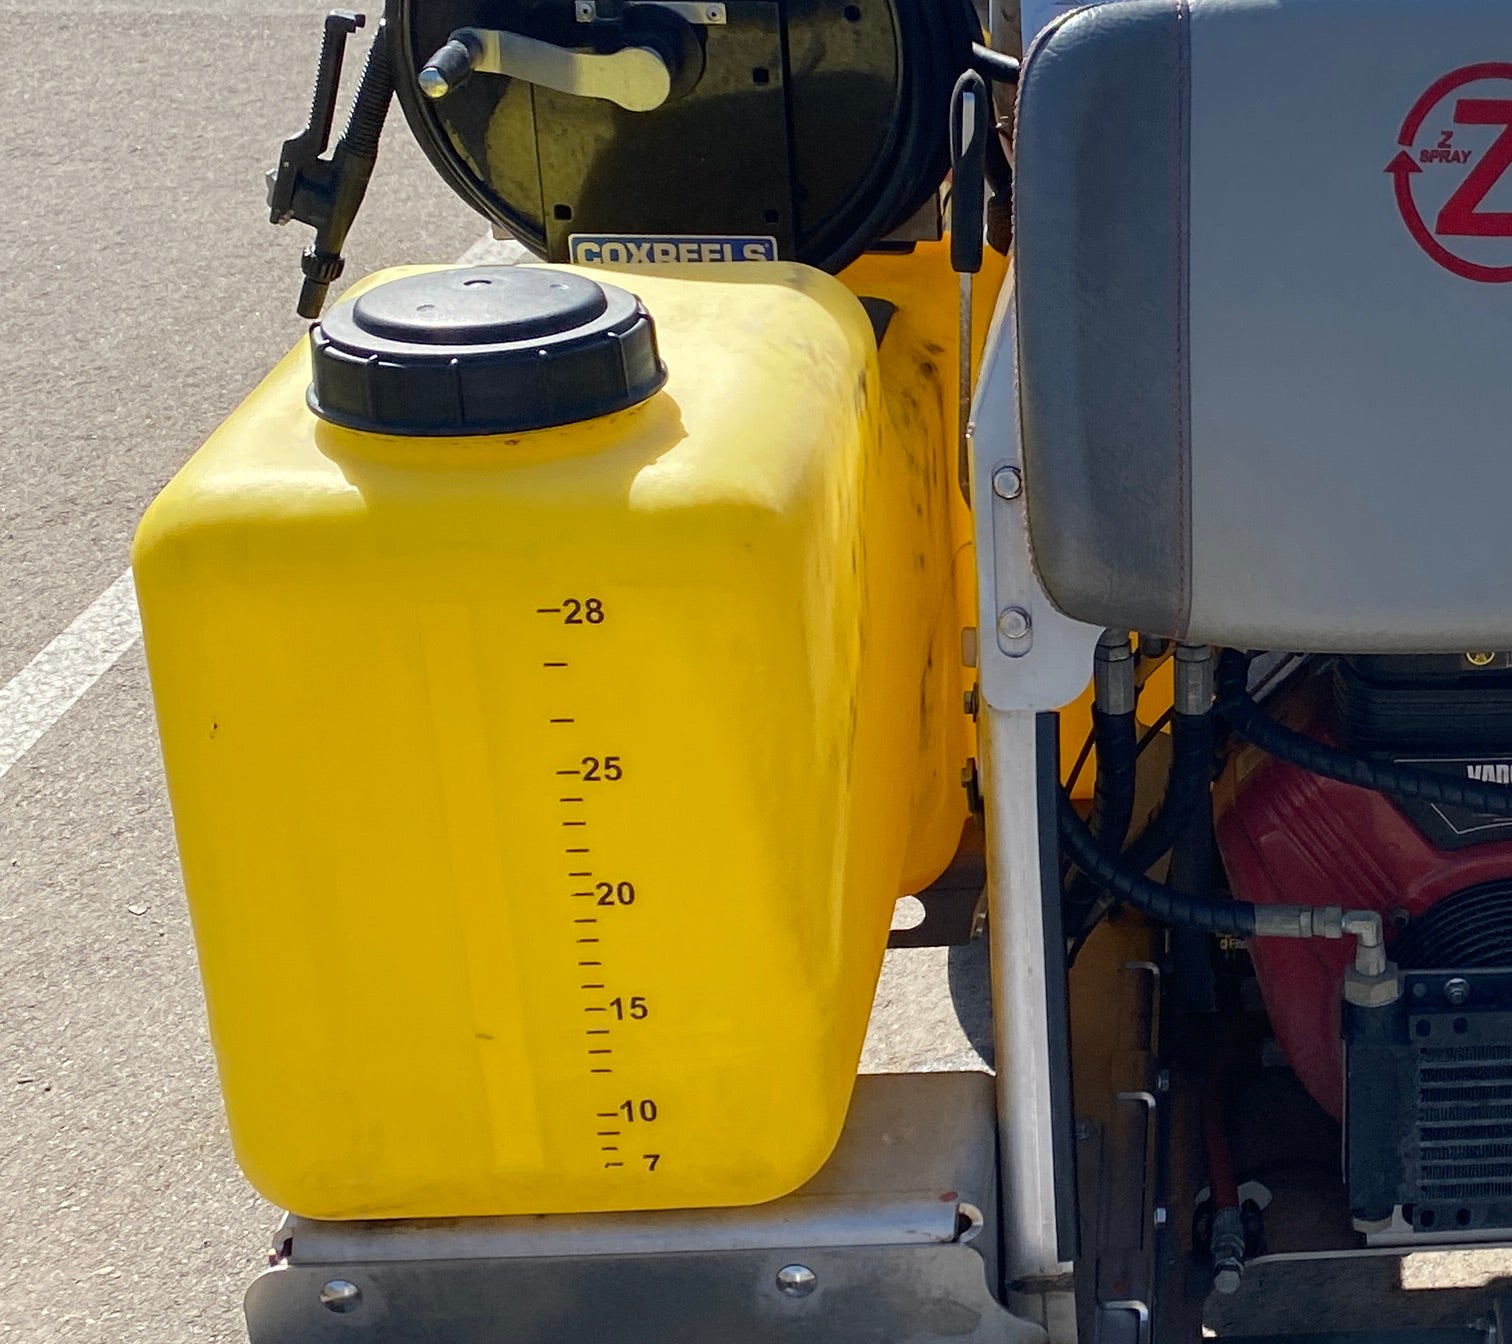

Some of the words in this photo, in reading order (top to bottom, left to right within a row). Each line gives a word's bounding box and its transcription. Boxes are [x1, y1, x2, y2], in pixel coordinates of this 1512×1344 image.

[1438, 131, 1454, 149] Z
[1419, 150, 1472, 164] SPRAY
[576, 241, 768, 263] COXREELS
[562, 598, 604, 624] 28
[581, 756, 623, 782] 25
[595, 881, 635, 906] 20
[609, 996, 648, 1021] 15
[620, 1099, 657, 1123] 10
[643, 1154, 660, 1171] 7
